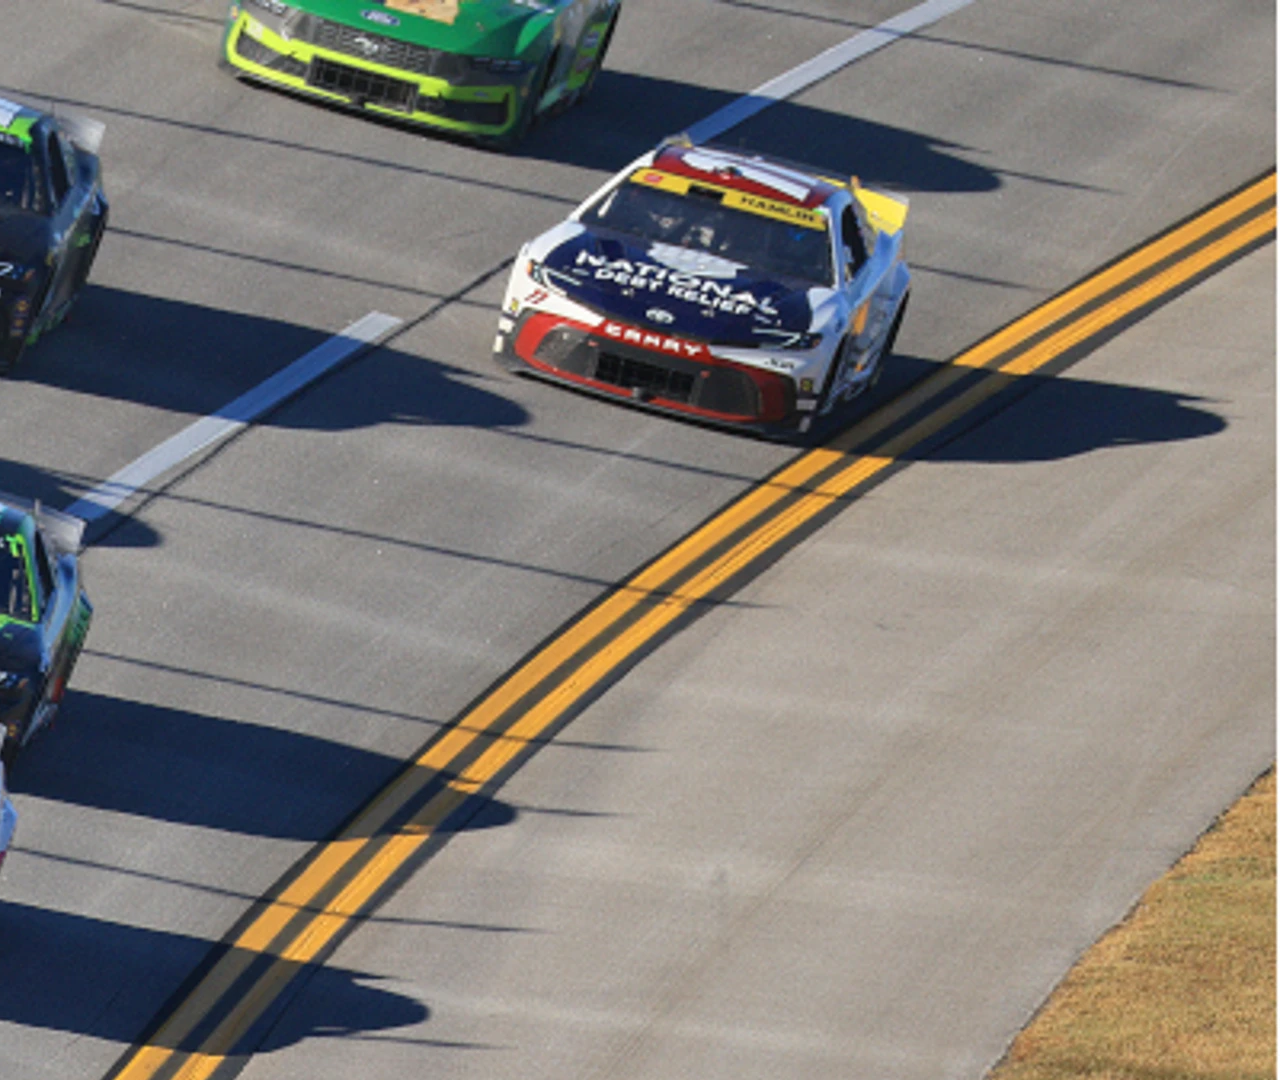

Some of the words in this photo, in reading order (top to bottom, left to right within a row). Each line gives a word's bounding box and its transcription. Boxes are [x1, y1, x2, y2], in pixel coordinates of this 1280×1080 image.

[575, 250, 779, 316] NATIONAL
[595, 268, 664, 295] DEBT
[667, 286, 753, 315] RELIEF
